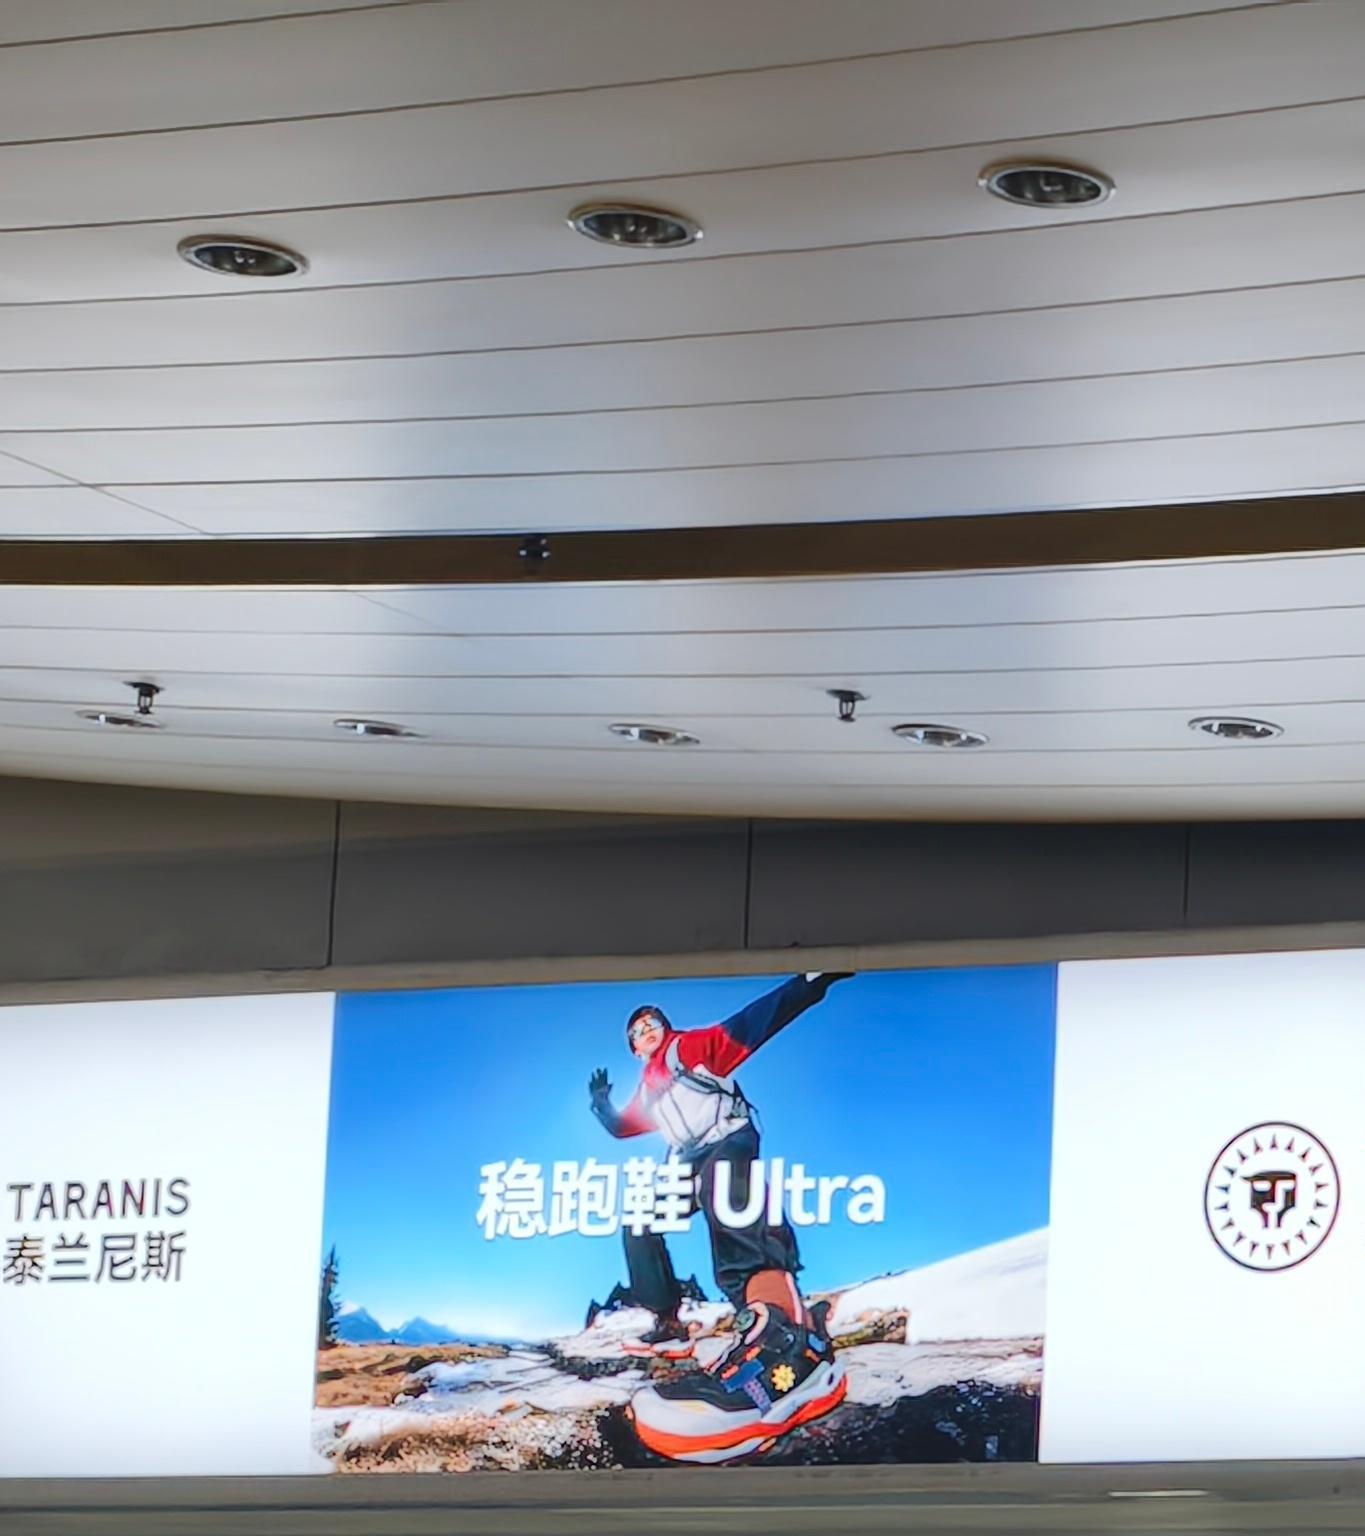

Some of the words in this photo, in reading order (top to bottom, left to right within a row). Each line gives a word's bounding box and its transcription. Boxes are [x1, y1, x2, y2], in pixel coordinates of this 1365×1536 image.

[8, 1177, 191, 1221] TARANIS
[475, 1156, 694, 1241] 稳跑鞋
[711, 1158, 887, 1231] Ultra
[3, 1231, 187, 1286] 泰兰尼斯
